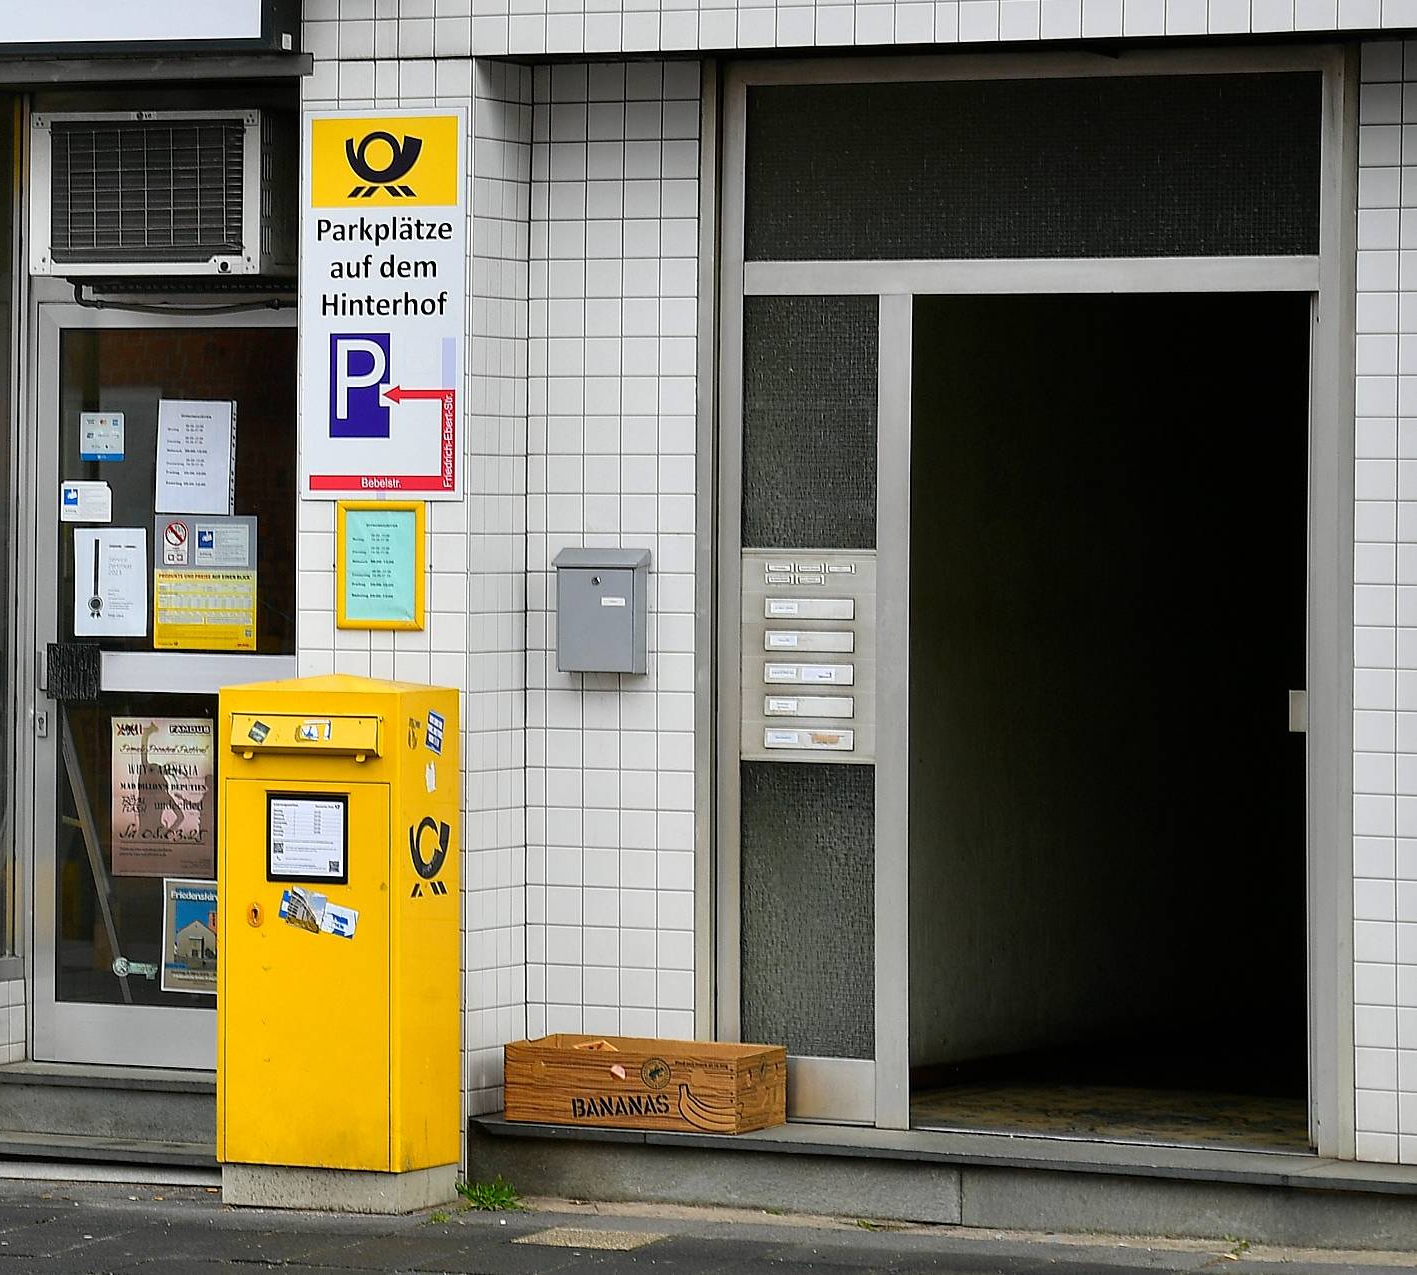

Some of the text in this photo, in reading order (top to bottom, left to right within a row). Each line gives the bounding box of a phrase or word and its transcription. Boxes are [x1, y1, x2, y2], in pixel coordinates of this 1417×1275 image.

[316, 217, 453, 247] Parkplätze
[330, 254, 437, 279] auf dem
[322, 291, 448, 317] Hinterhof
[336, 338, 387, 420] P
[442, 392, 455, 489] Friedrich-Ebert-Str.
[360, 477, 402, 489] Bebelstr.
[170, 889, 218, 901] Friedenskir
[570, 1094, 670, 1119] BANANAS
